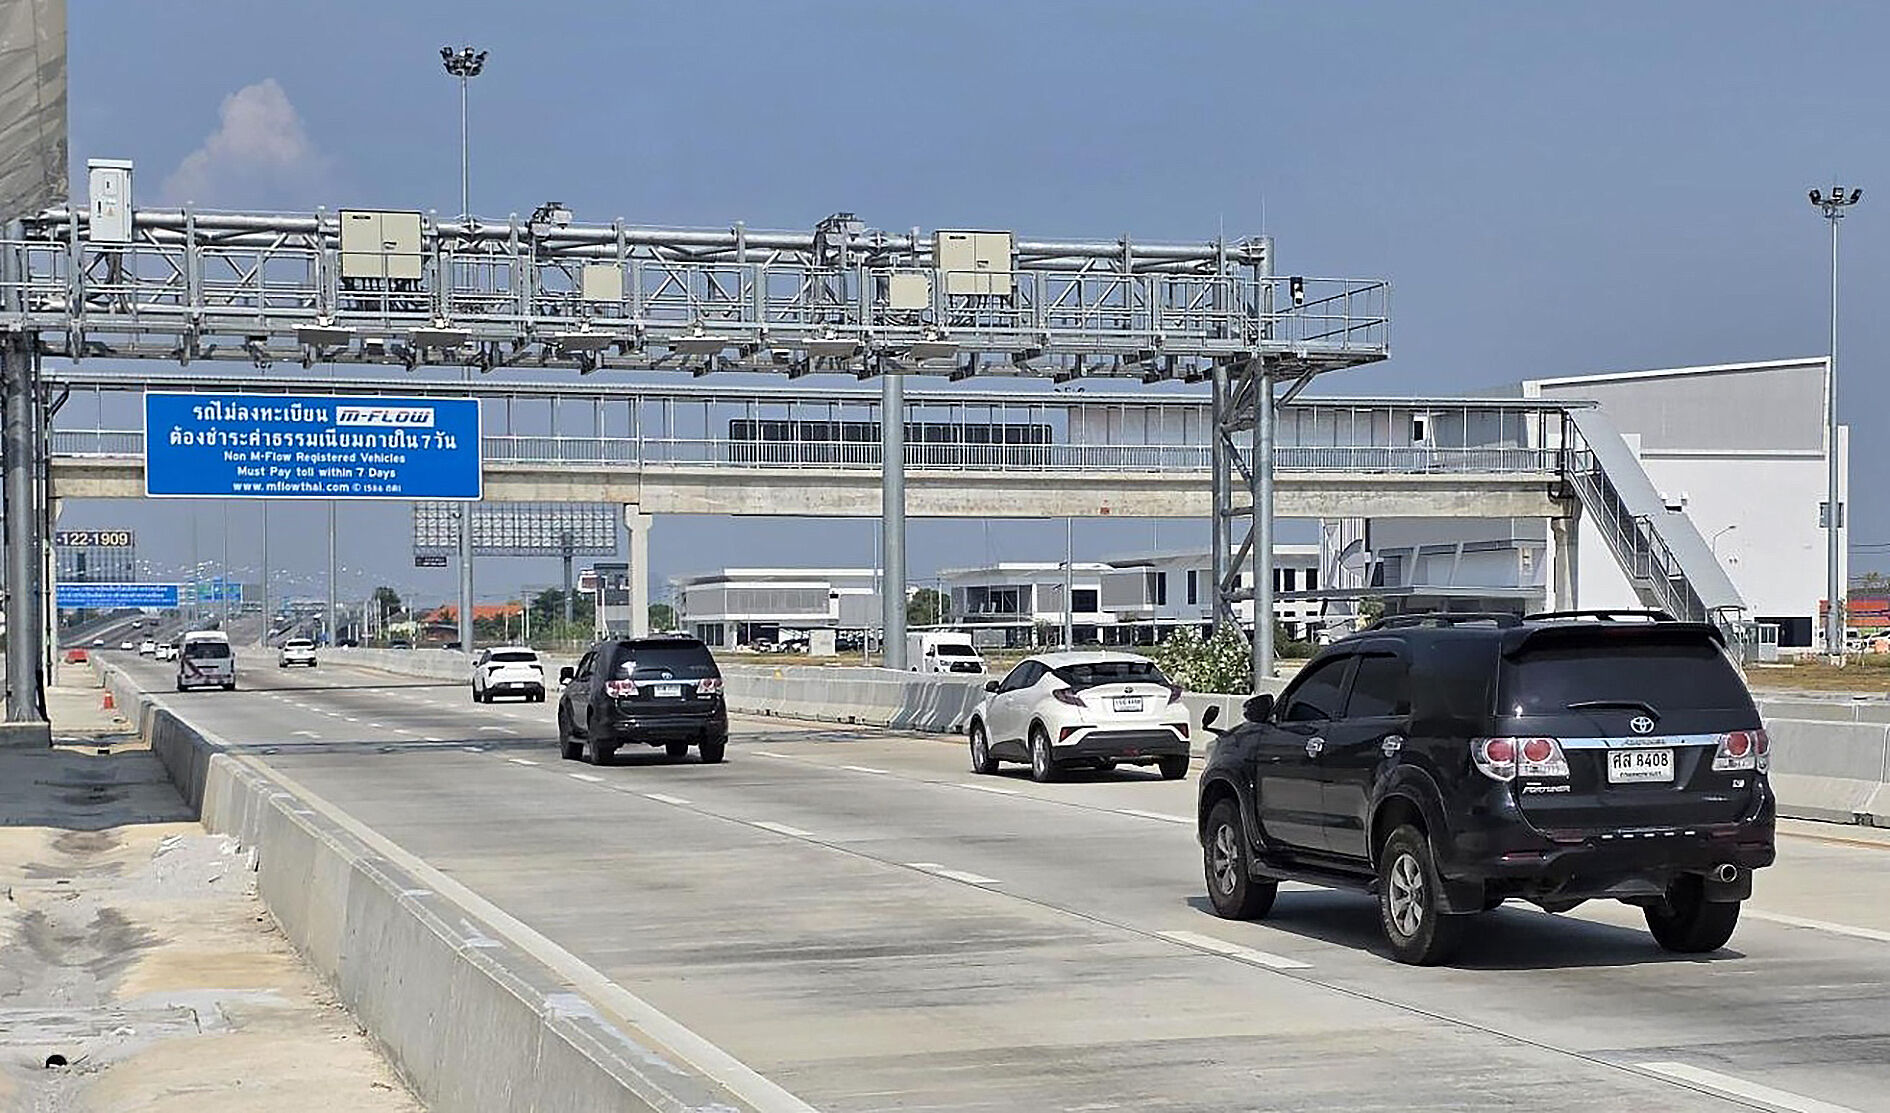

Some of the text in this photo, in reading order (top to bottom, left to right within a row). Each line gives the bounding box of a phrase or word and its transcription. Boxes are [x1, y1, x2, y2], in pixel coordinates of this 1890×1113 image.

[192, 400, 329, 422] รถไม่ลงทะเบียน
[421, 435, 432, 449] 7
[434, 430, 458, 449] วัน
[224, 451, 246, 462] Non
[296, 452, 356, 464] Registered
[360, 453, 406, 463] Vehicles
[237, 466, 396, 480] Must Pay toll within 7 Days
[1636, 753, 1669, 767] 8408
